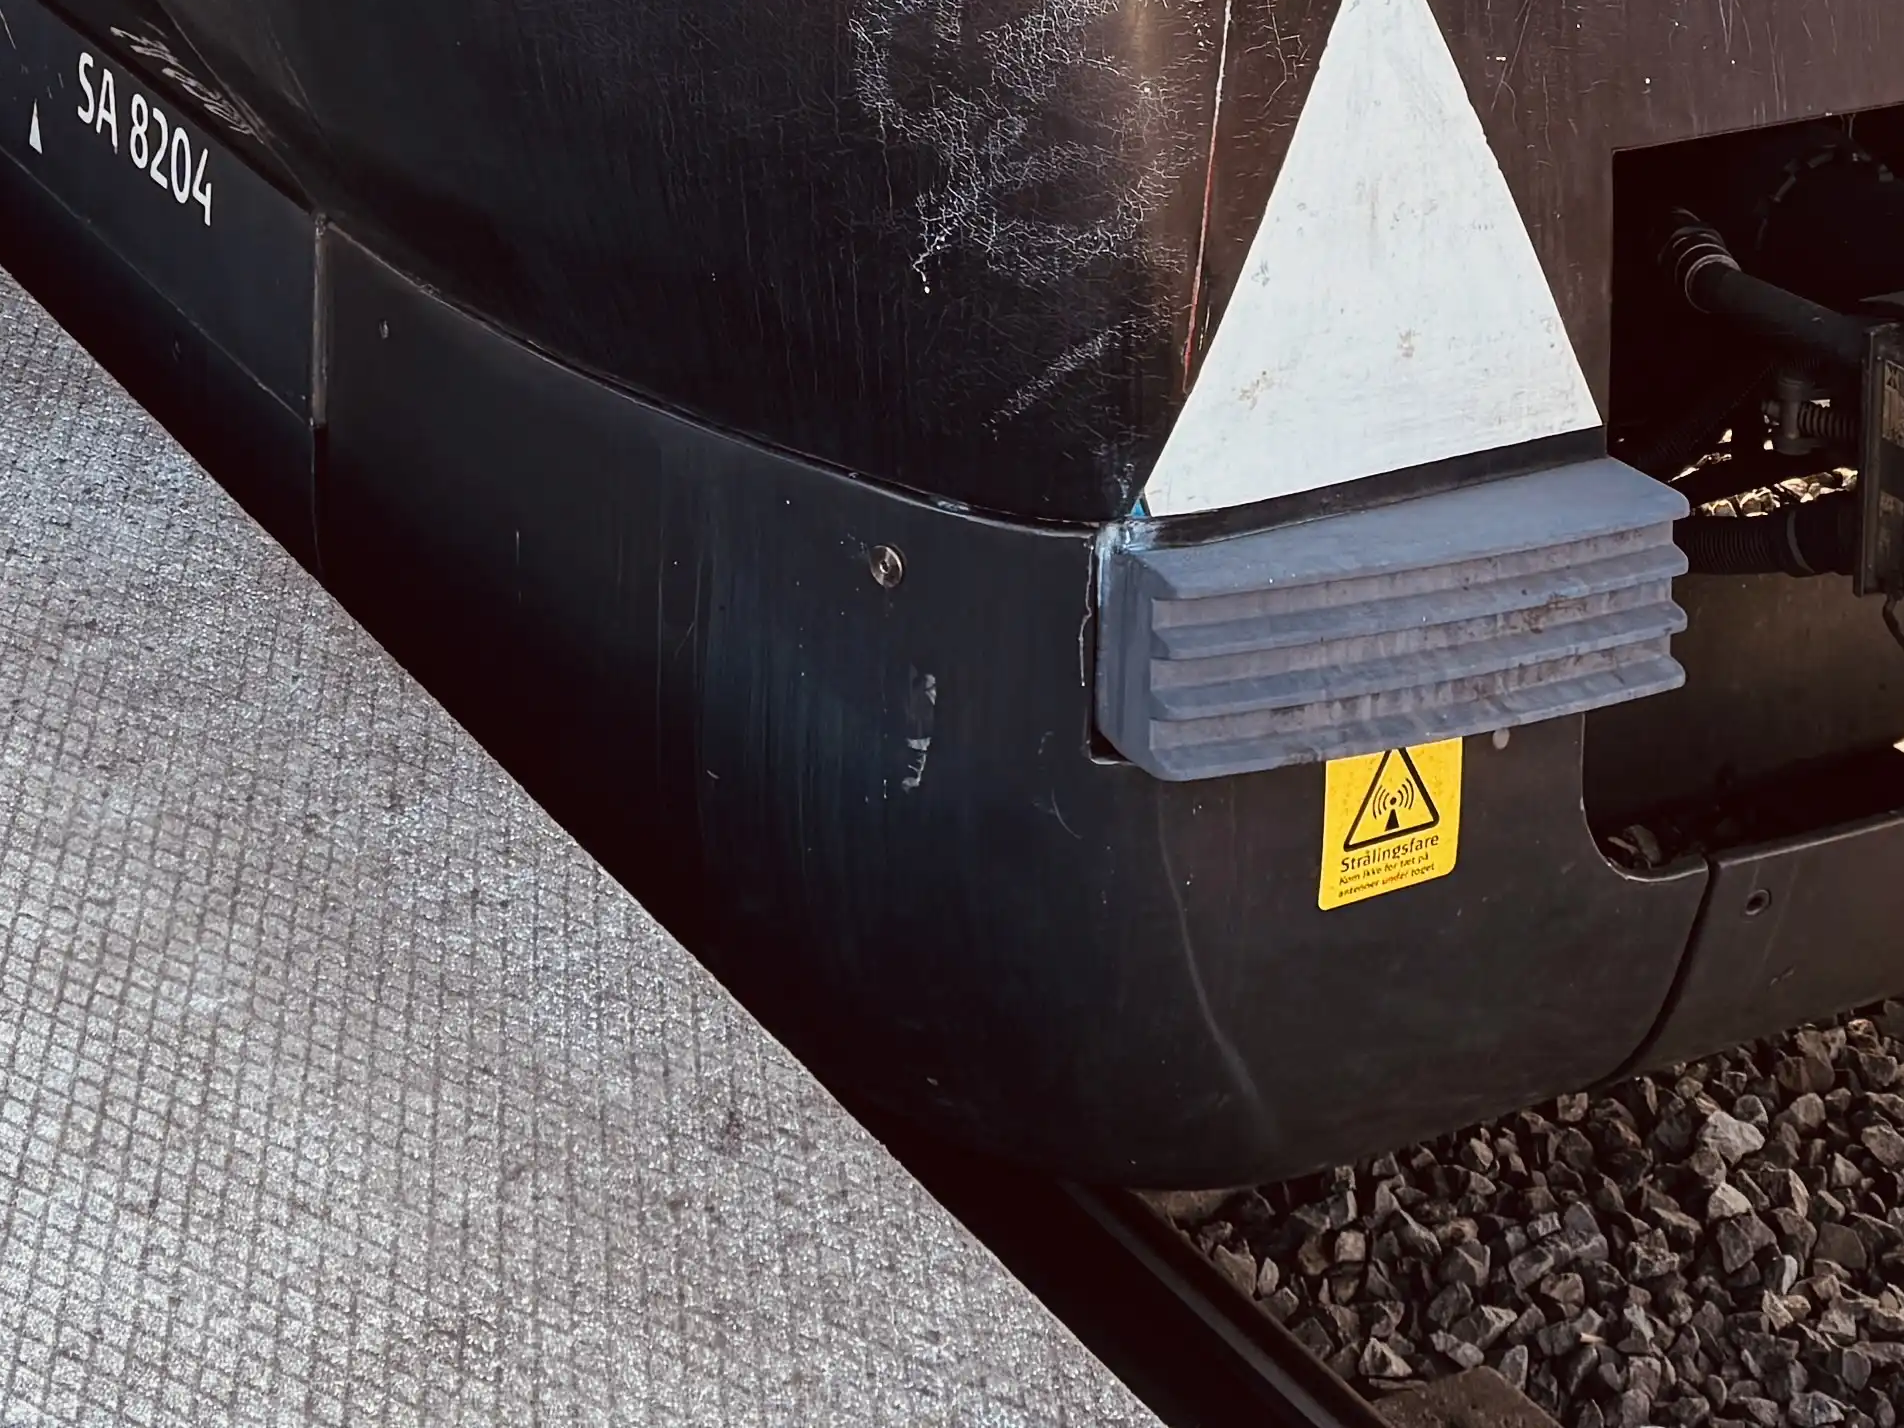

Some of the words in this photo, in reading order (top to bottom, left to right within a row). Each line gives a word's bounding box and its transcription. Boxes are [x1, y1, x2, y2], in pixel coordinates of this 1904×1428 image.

[76, 51, 119, 155] SA
[128, 93, 212, 227] 8204
[1340, 834, 1440, 874] Strålingsfare
